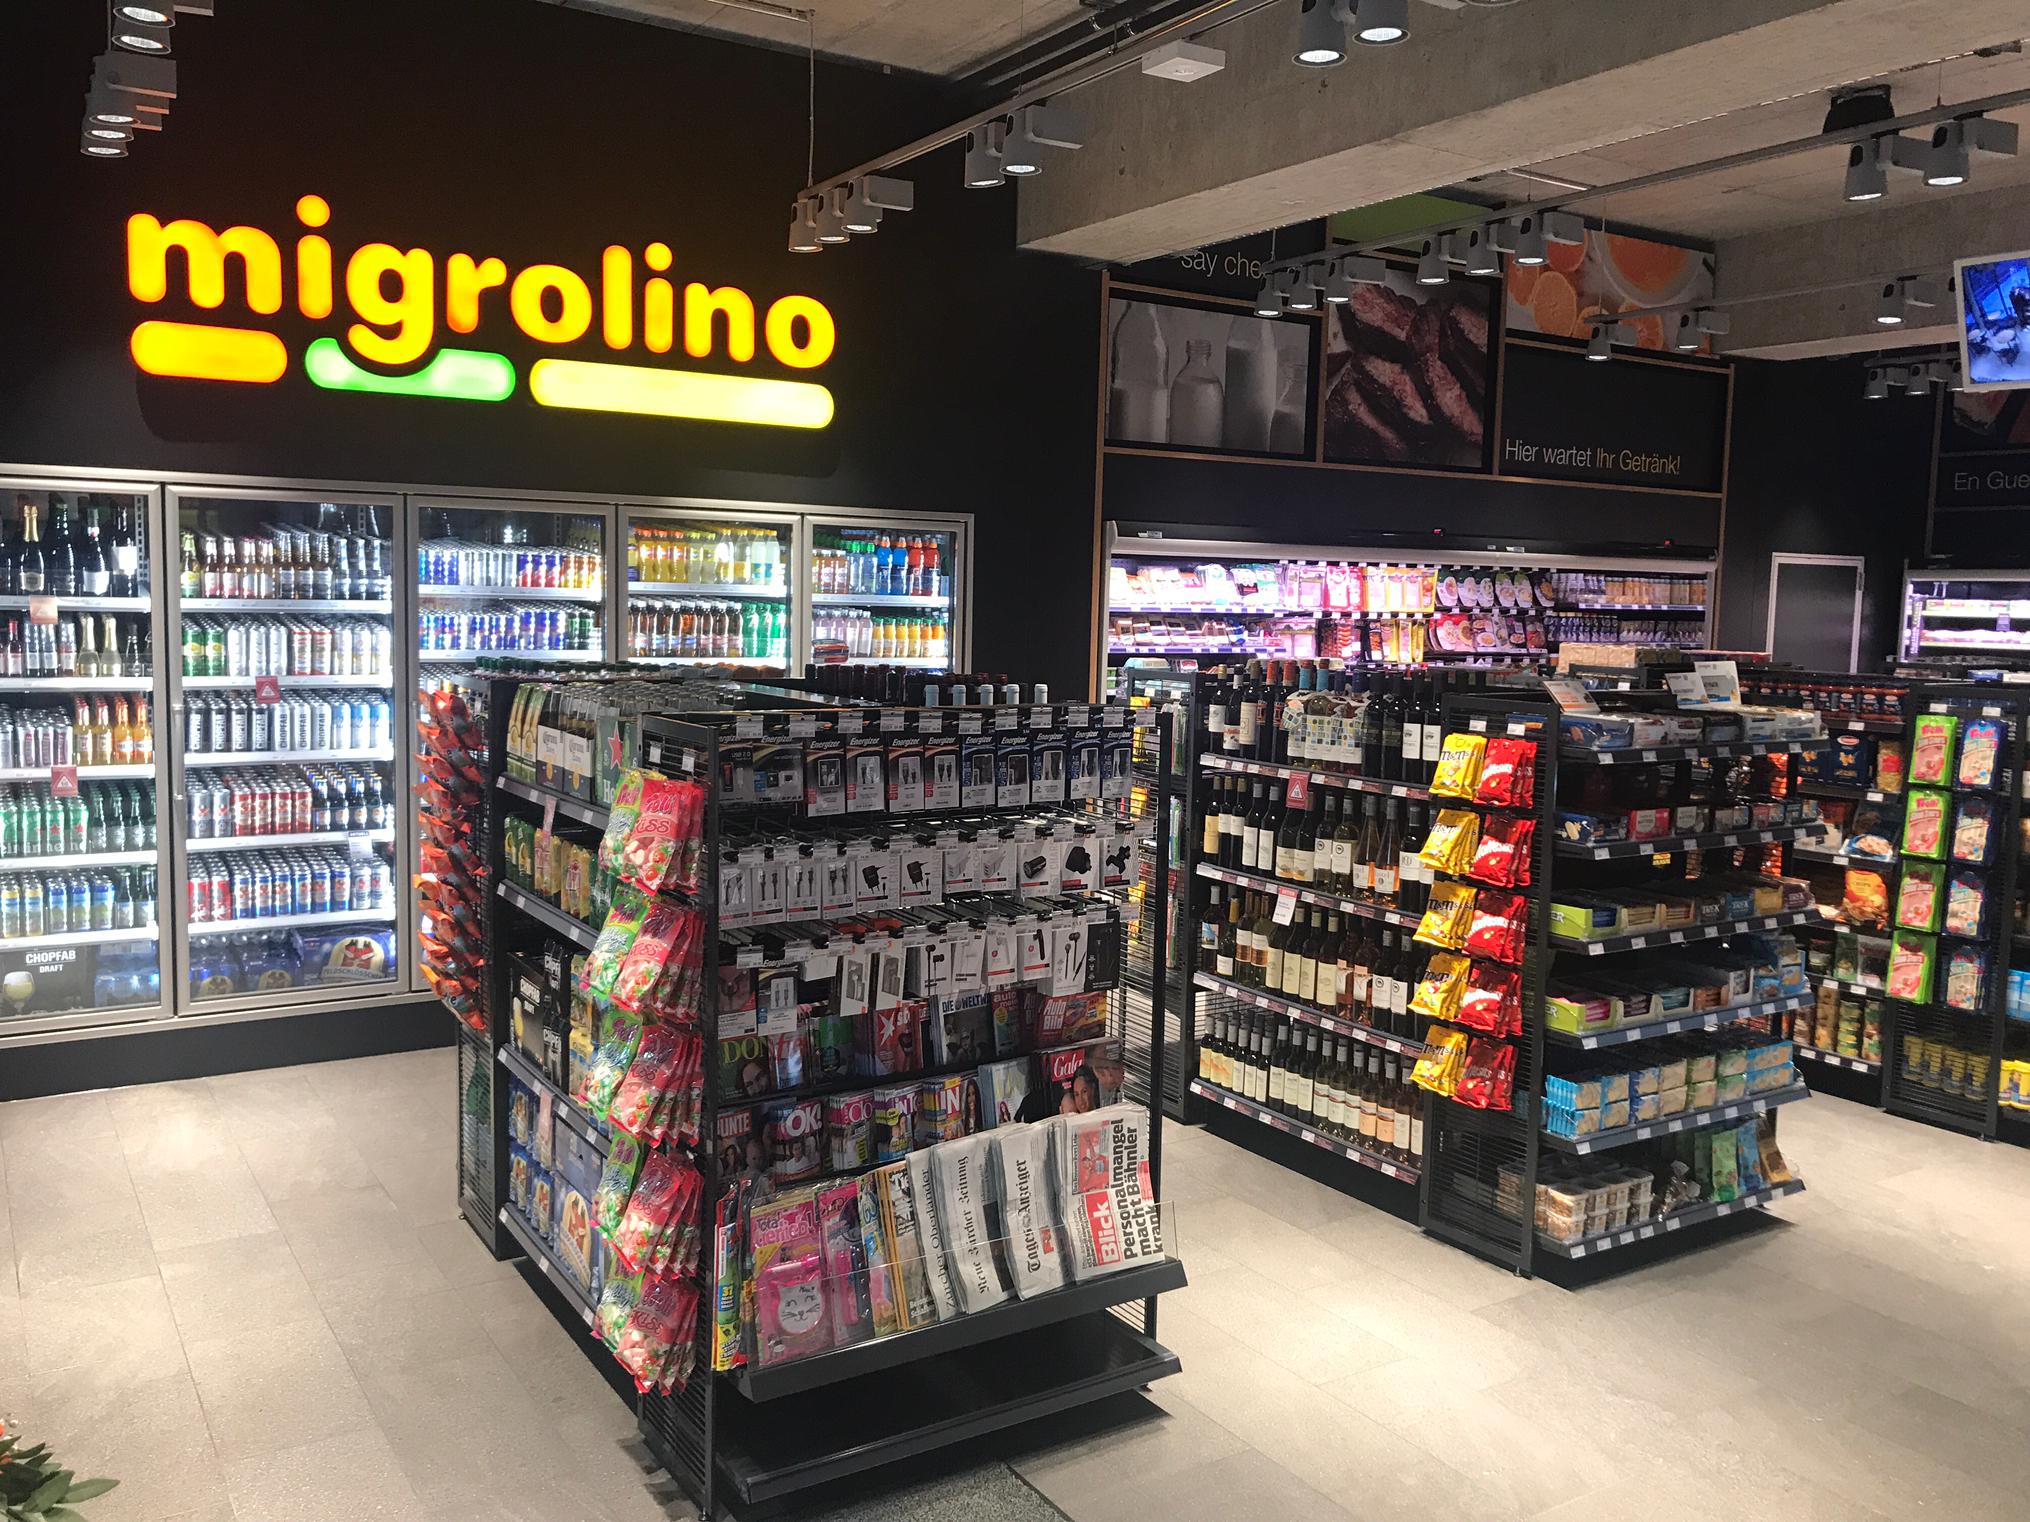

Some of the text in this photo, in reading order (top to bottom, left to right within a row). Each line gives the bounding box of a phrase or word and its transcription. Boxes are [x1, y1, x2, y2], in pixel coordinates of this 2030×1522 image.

[1181, 250, 1264, 280] say che
[127, 194, 837, 369] migrolino
[1505, 439, 1680, 475] Hier wartet Ihr Getränk!
[1954, 472, 1980, 490] En
[849, 737, 881, 746] Energizer
[891, 738, 921, 747] Energizer
[927, 736, 956, 746] Energizer
[965, 735, 993, 744] Energizer
[1001, 736, 1028, 745] Energizer
[1036, 732, 1064, 741] Energizer
[1074, 730, 1099, 738] Energizer
[1106, 730, 1132, 738] Energizer
[810, 740, 841, 749] Energizer
[26, 950, 77, 964] CHOPFAB
[40, 964, 64, 974] DRAFT
[942, 994, 989, 1013] DIE WELTW
[1044, 998, 1066, 1016] Auto
[1043, 1015, 1064, 1030] Bild
[785, 1103, 823, 1137] OK!
[1123, 1126, 1141, 1196] Bähnler
[957, 1155, 970, 1204] Zeitung
[1110, 1119, 1138, 1260] Personalmangel
[921, 1168, 941, 1250] Oberländer
[1015, 1159, 1041, 1274] Tages Anzeiger
[1092, 1200, 1122, 1262] Blick
[1130, 1198, 1153, 1257] macht
